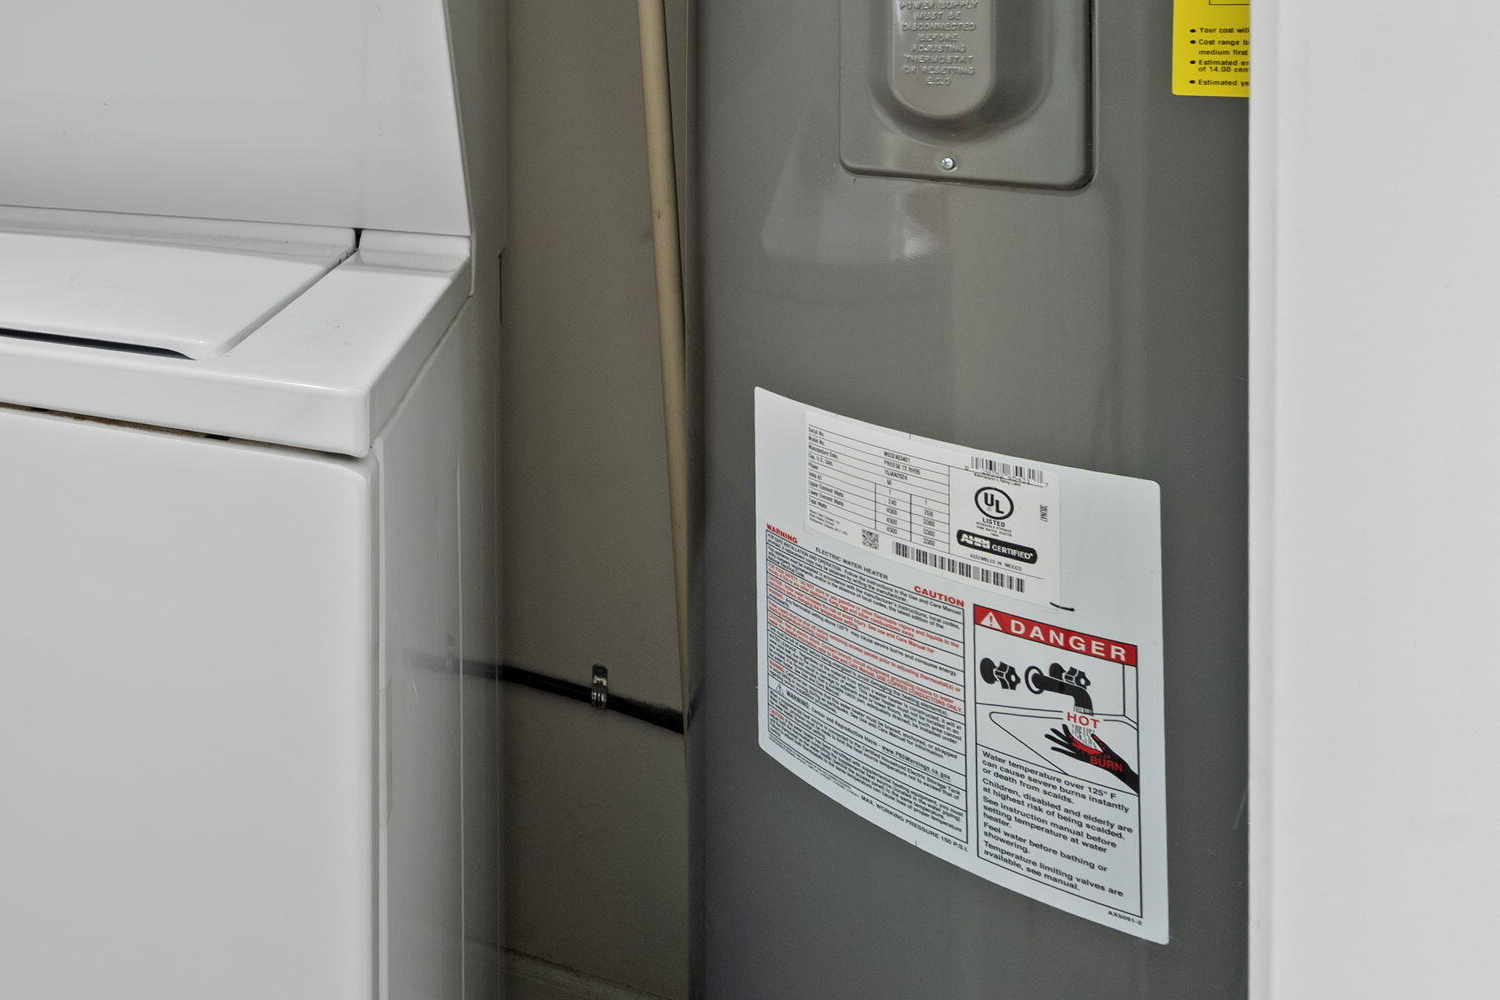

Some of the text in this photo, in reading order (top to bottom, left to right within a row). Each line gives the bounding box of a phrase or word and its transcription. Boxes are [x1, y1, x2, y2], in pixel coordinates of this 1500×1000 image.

[982, 517, 1006, 528] LISTED
[984, 492, 1004, 515] UL
[766, 523, 798, 544] WARNING
[815, 546, 888, 580] ELECTRIC WATER HEATER
[913, 585, 965, 608] CAUTION
[1010, 620, 1126, 662] DANGER
[1066, 712, 1100, 729] HOT
[982, 750, 1006, 764] Water
[1008, 760, 1062, 784] temperature
[1064, 780, 1085, 791] over
[1090, 756, 1123, 772] BURN
[982, 760, 1130, 813] can cause severe burns instantly
[982, 777, 1133, 833] Children, disabled and elderly are
[993, 771, 1017, 785] death
[1020, 780, 1040, 793] from
[1043, 789, 1075, 804] scalds.
[876, 804, 904, 822] WORKING
[905, 819, 940, 840] PRESSURE
[941, 836, 952, 845] 150
[982, 786, 1125, 840] at highest risk of being scalded.
[982, 795, 1117, 849] See instruction manual before
[983, 811, 1011, 828] heater.
[983, 805, 1107, 853] setting temperature at water
[983, 831, 1030, 854] showering.
[983, 821, 1108, 872] Feel water before bathing or
[984, 840, 1124, 897] Temperature limiting valves are
[984, 849, 1080, 891] available, see manual.
